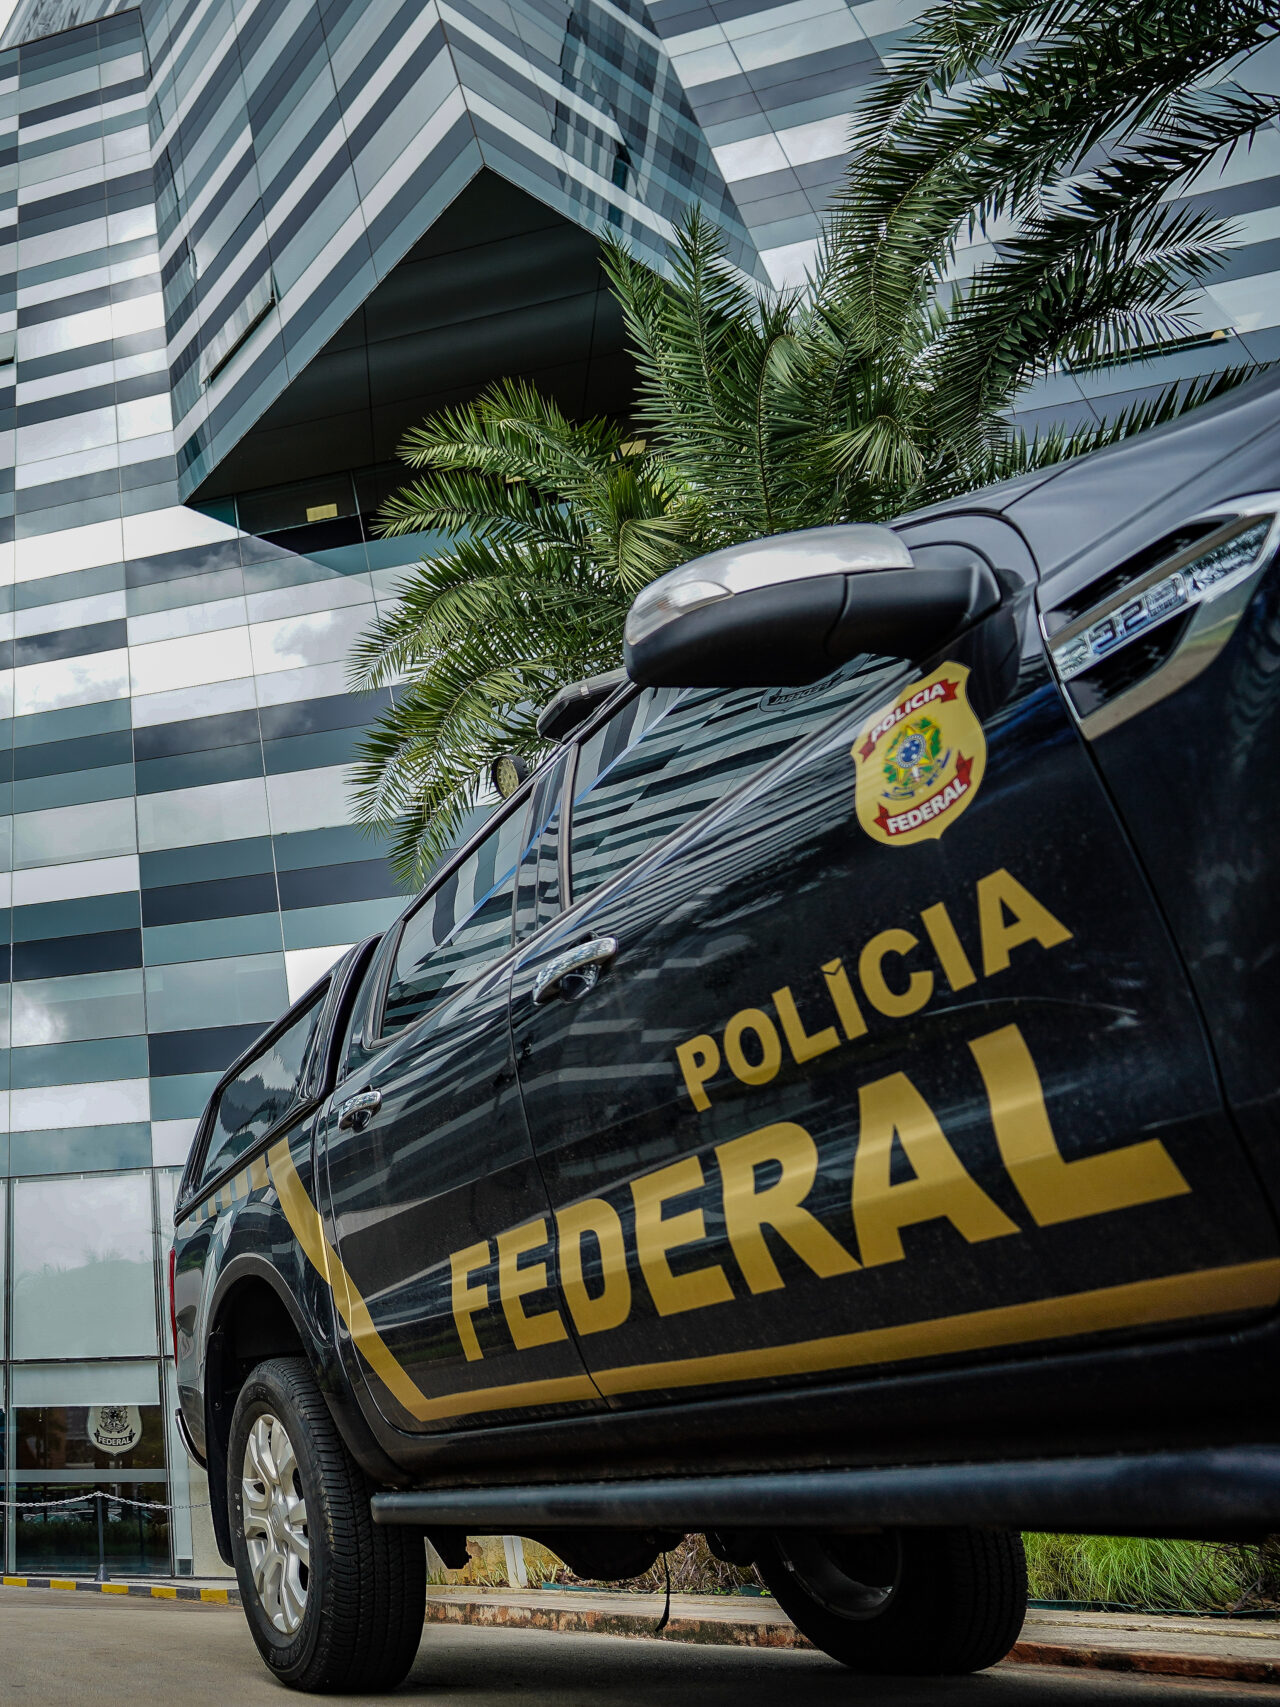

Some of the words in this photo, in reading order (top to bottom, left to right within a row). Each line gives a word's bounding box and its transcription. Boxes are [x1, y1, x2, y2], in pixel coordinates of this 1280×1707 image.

[1091, 600, 1147, 648] 3.2
[871, 683, 946, 742] POLICIA
[886, 778, 968, 833] FEDERAL
[676, 867, 1074, 1112] POLÍCIA
[449, 1023, 1191, 1362] FEDERAL
[98, 1437, 132, 1446] FEDERAL
